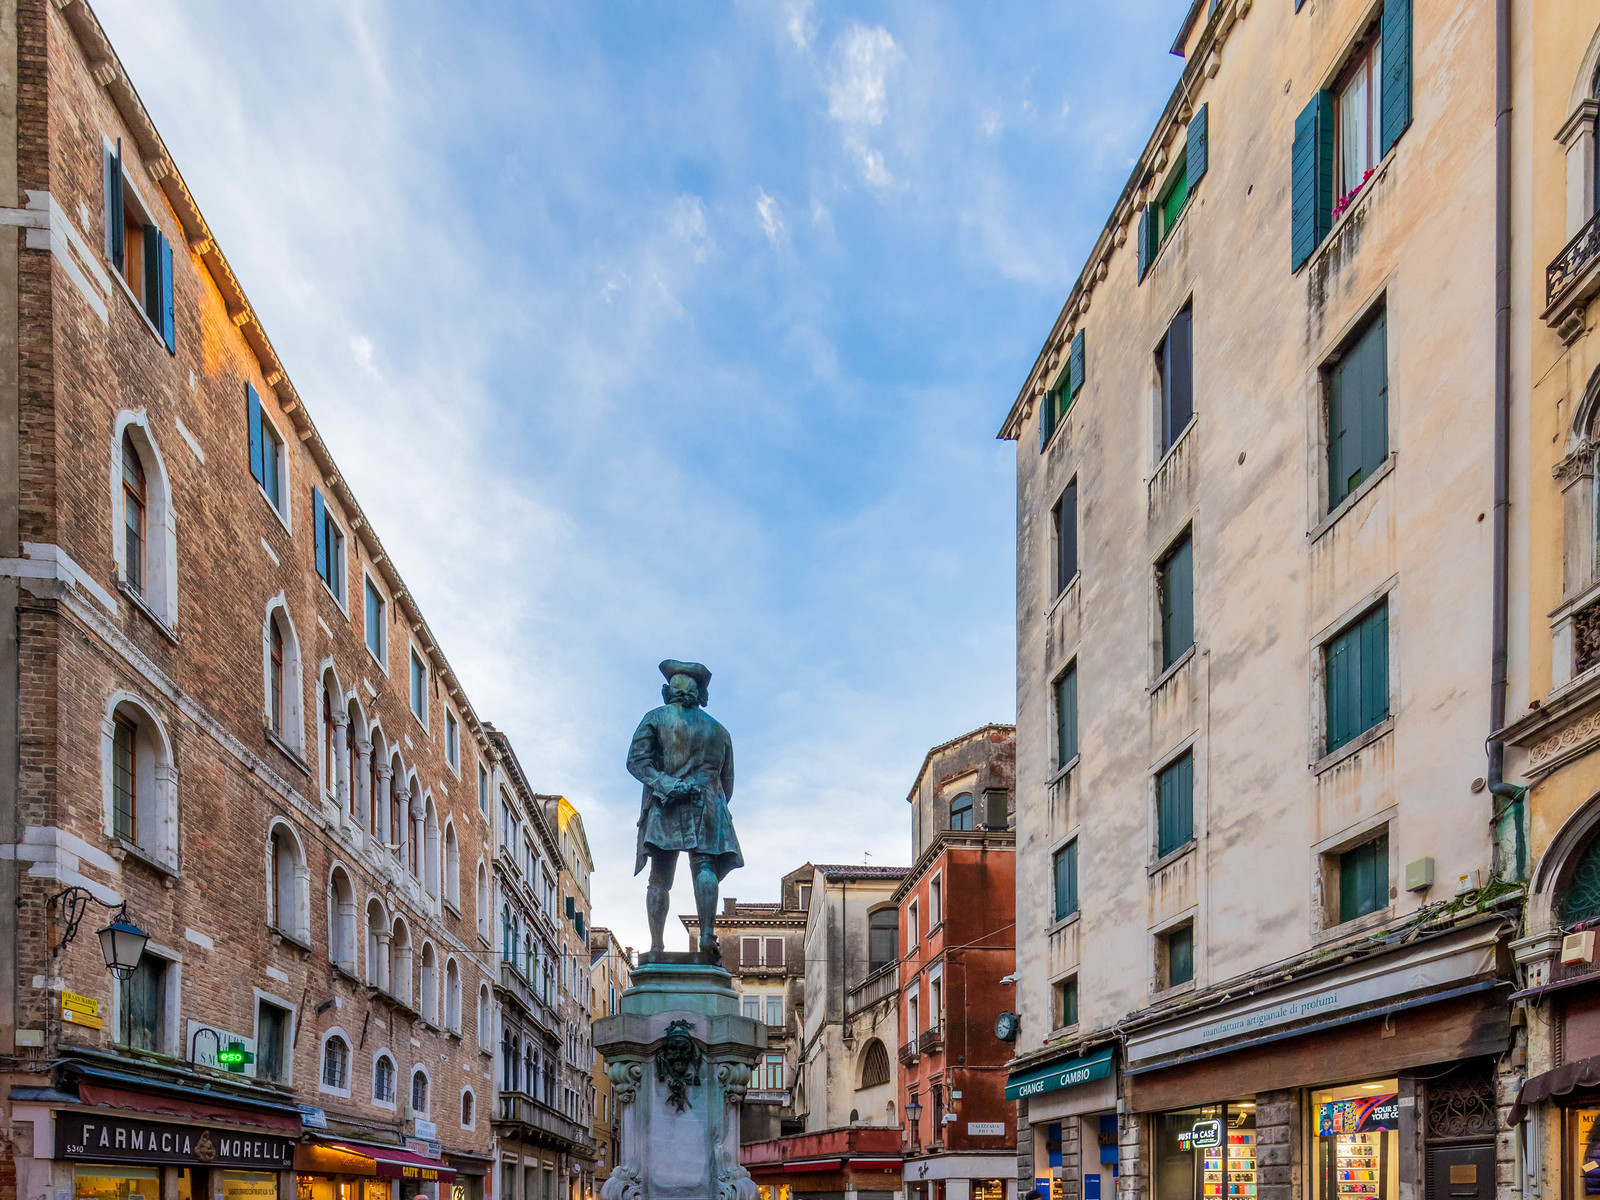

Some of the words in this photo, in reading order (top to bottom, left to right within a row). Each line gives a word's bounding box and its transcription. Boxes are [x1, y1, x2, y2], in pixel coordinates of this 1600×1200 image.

[1203, 1021, 1245, 1037] manifattura
[1246, 1007, 1287, 1026] artigianale
[1290, 1001, 1298, 1014] di
[1301, 993, 1338, 1015] profumi
[221, 1053, 242, 1061] eso
[1019, 1081, 1045, 1097] CHANGE
[1060, 1068, 1090, 1086] CAMBIO
[1373, 1105, 1392, 1114] YOUR
[1371, 1111, 1390, 1120] YOUR
[1178, 1132, 1191, 1140] JUST
[1192, 1131, 1199, 1139] in
[1200, 1130, 1215, 1139] CASE
[83, 1124, 191, 1154] FARMACIA
[220, 1138, 286, 1160] MORELLI
